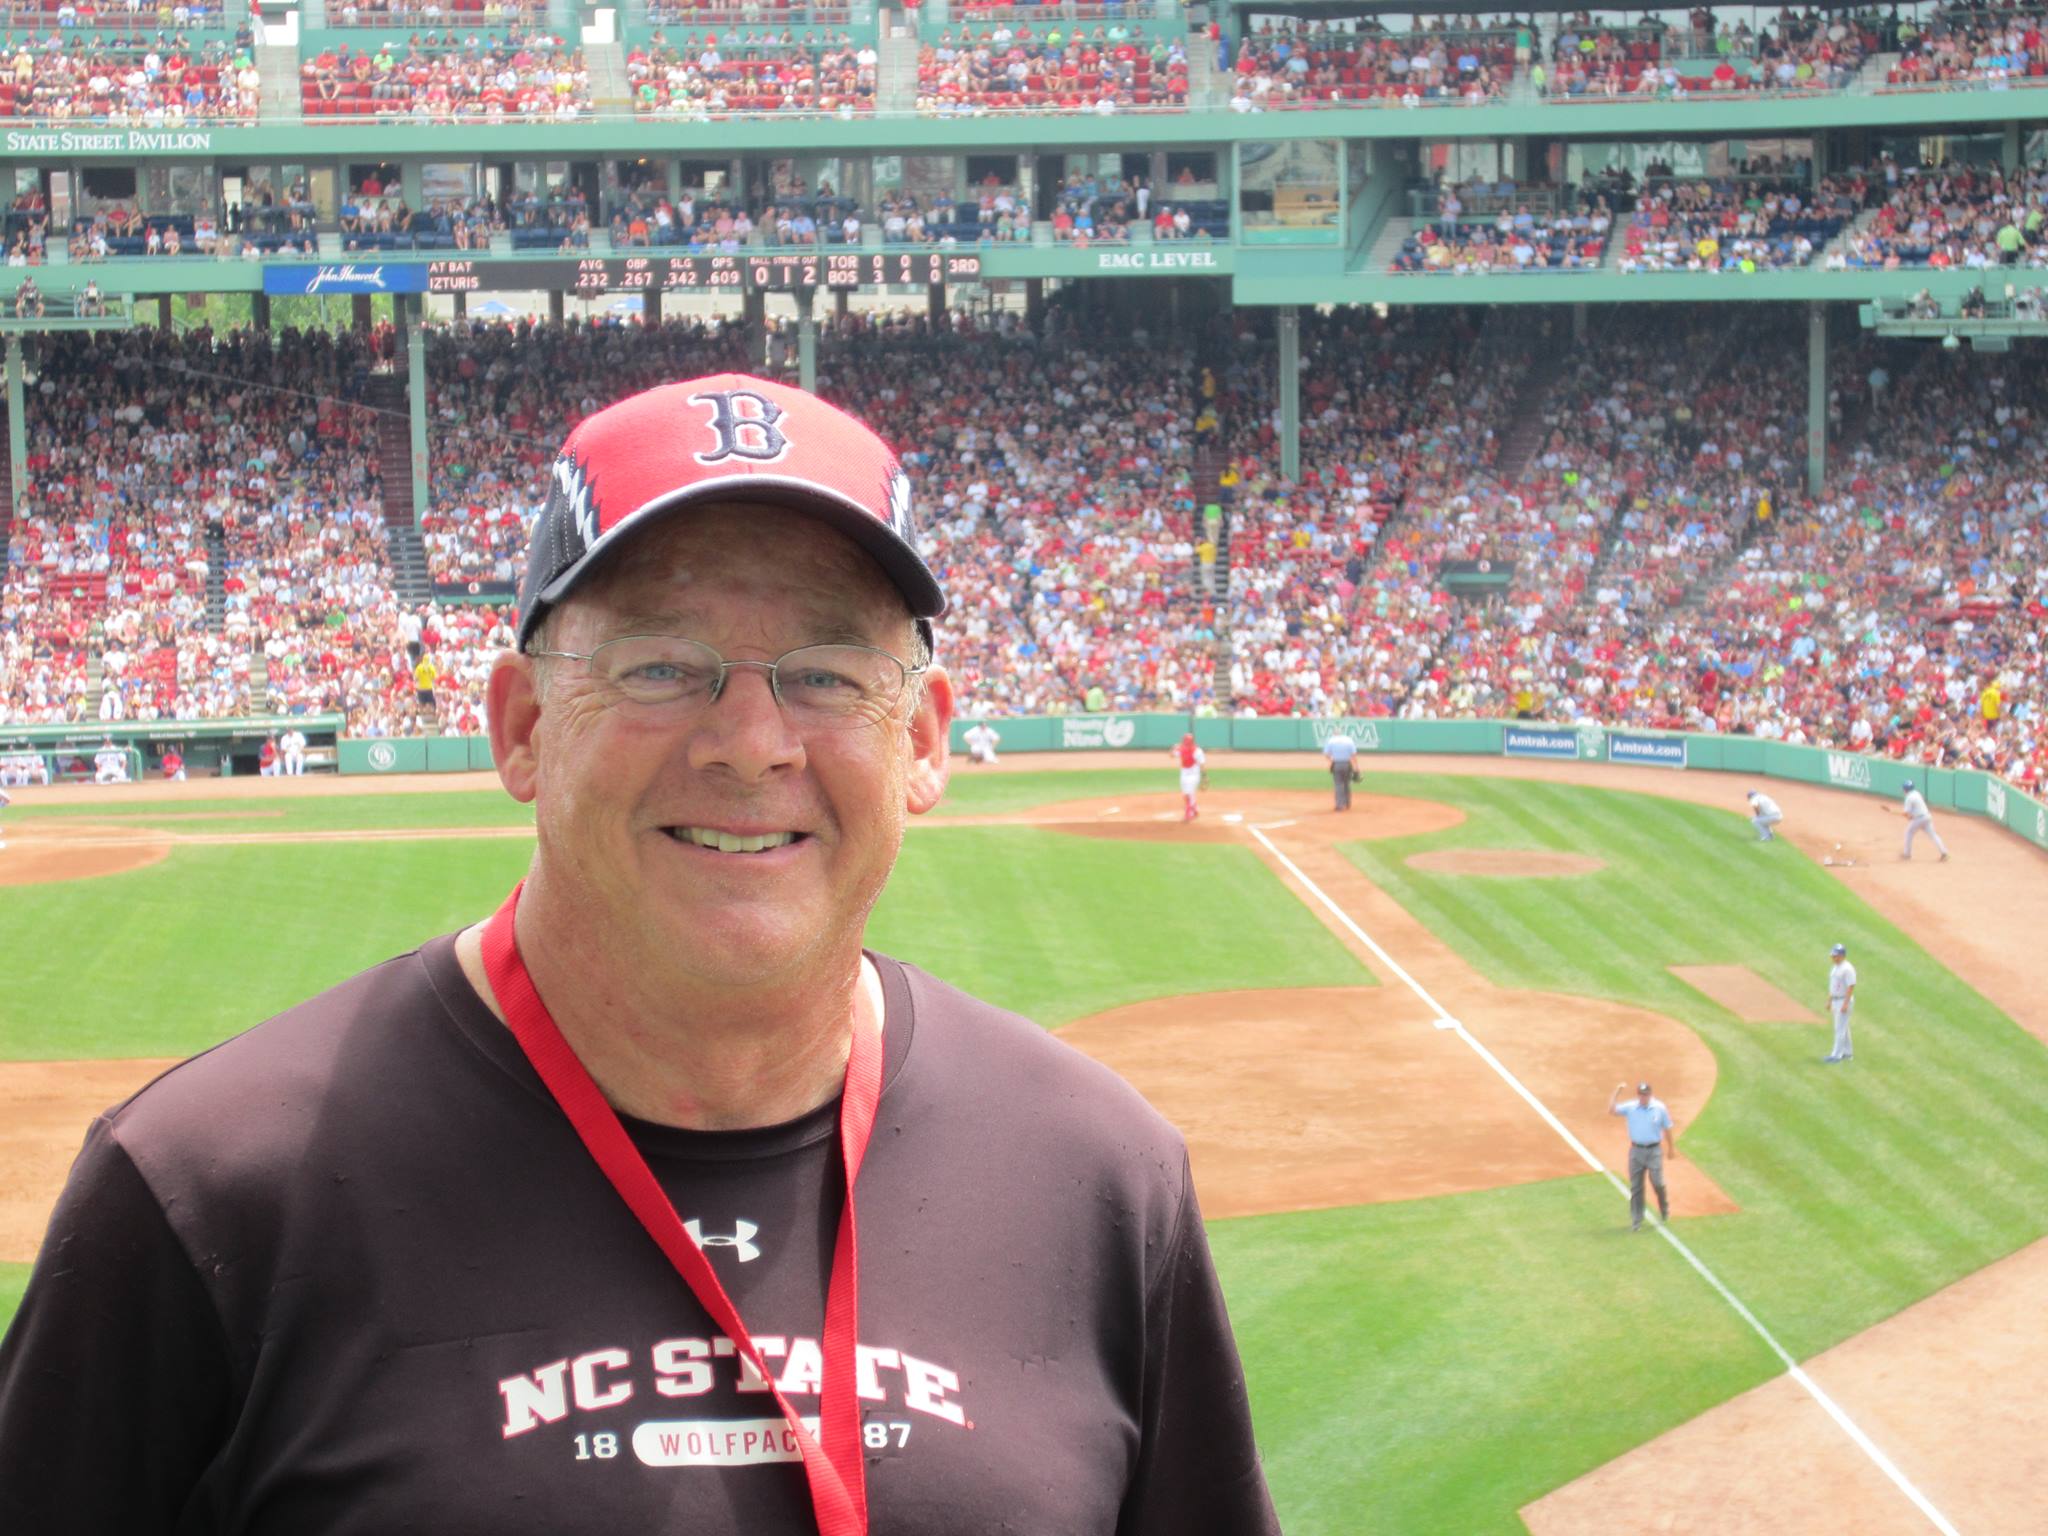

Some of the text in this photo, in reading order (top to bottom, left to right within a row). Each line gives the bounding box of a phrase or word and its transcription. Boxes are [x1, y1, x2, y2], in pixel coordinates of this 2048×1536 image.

[7, 131, 211, 151] STATE STREET PAVILION
[429, 261, 472, 273] AT BAT
[578, 257, 734, 269] AVG OBP SLG OPS
[749, 256, 817, 265] BALL STRIKE OUT
[828, 254, 940, 268] TOR 0 0 0
[949, 259, 980, 273] 3RD
[1098, 252, 1217, 268] EMC LEVEL
[305, 265, 338, 293] John
[429, 276, 479, 289] IZTURIS
[575, 271, 740, 287] .232 .267 .342 .609
[755, 266, 816, 284] 0 1 2
[828, 269, 941, 283] BOS 3 4 0
[688, 391, 794, 466] B
[1509, 734, 1575, 749] Amtrak.com
[1614, 740, 1682, 756] Amtrak.com
[498, 1335, 967, 1440] NC STATE
[573, 1422, 912, 1461] 18 WOLFPAC 87
